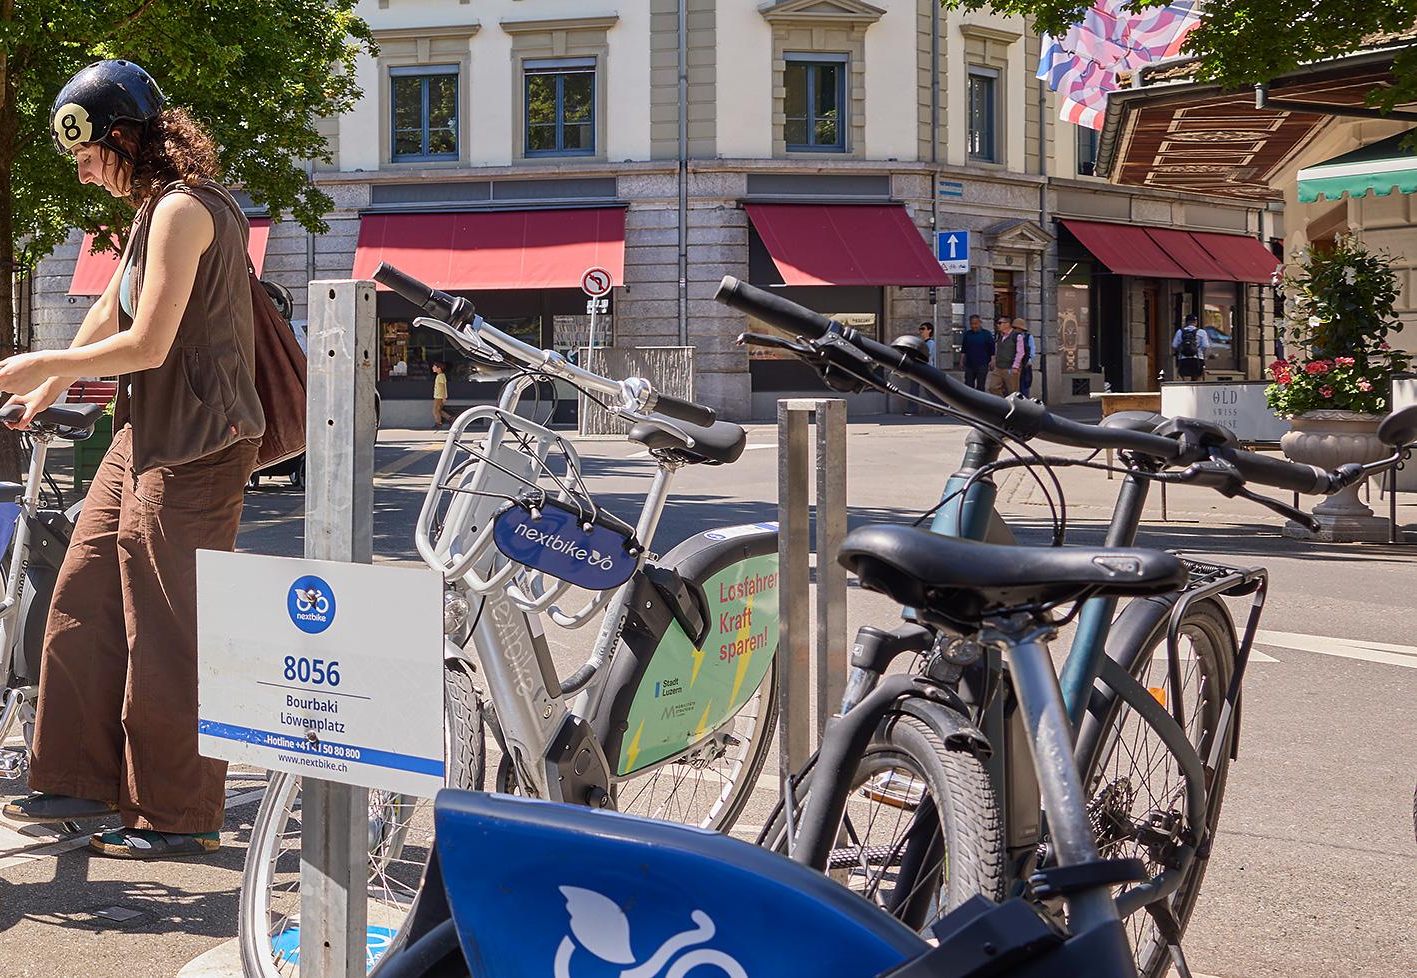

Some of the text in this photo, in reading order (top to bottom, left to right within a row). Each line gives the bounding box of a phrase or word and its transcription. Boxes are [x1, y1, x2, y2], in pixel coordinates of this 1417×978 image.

[62, 114, 81, 140] 8
[1213, 390, 1237, 404] OLD
[514, 523, 587, 560] nextbike
[296, 613, 327, 622] nextbike
[720, 608, 752, 634] Kraft
[719, 626, 768, 663] sparen!
[284, 655, 340, 687] 8056
[662, 687, 682, 696] Luzern
[663, 678, 679, 688] Stadt
[286, 695, 338, 713] Bourbaki
[280, 712, 345, 733] Löwenplatz
[267, 735, 294, 748] Hotline
[295, 741, 310, 751] +41
[323, 744, 333, 755] 50
[334, 746, 344, 756] 80
[345, 748, 360, 759] 800
[278, 753, 348, 772] www.nextbike.ch
